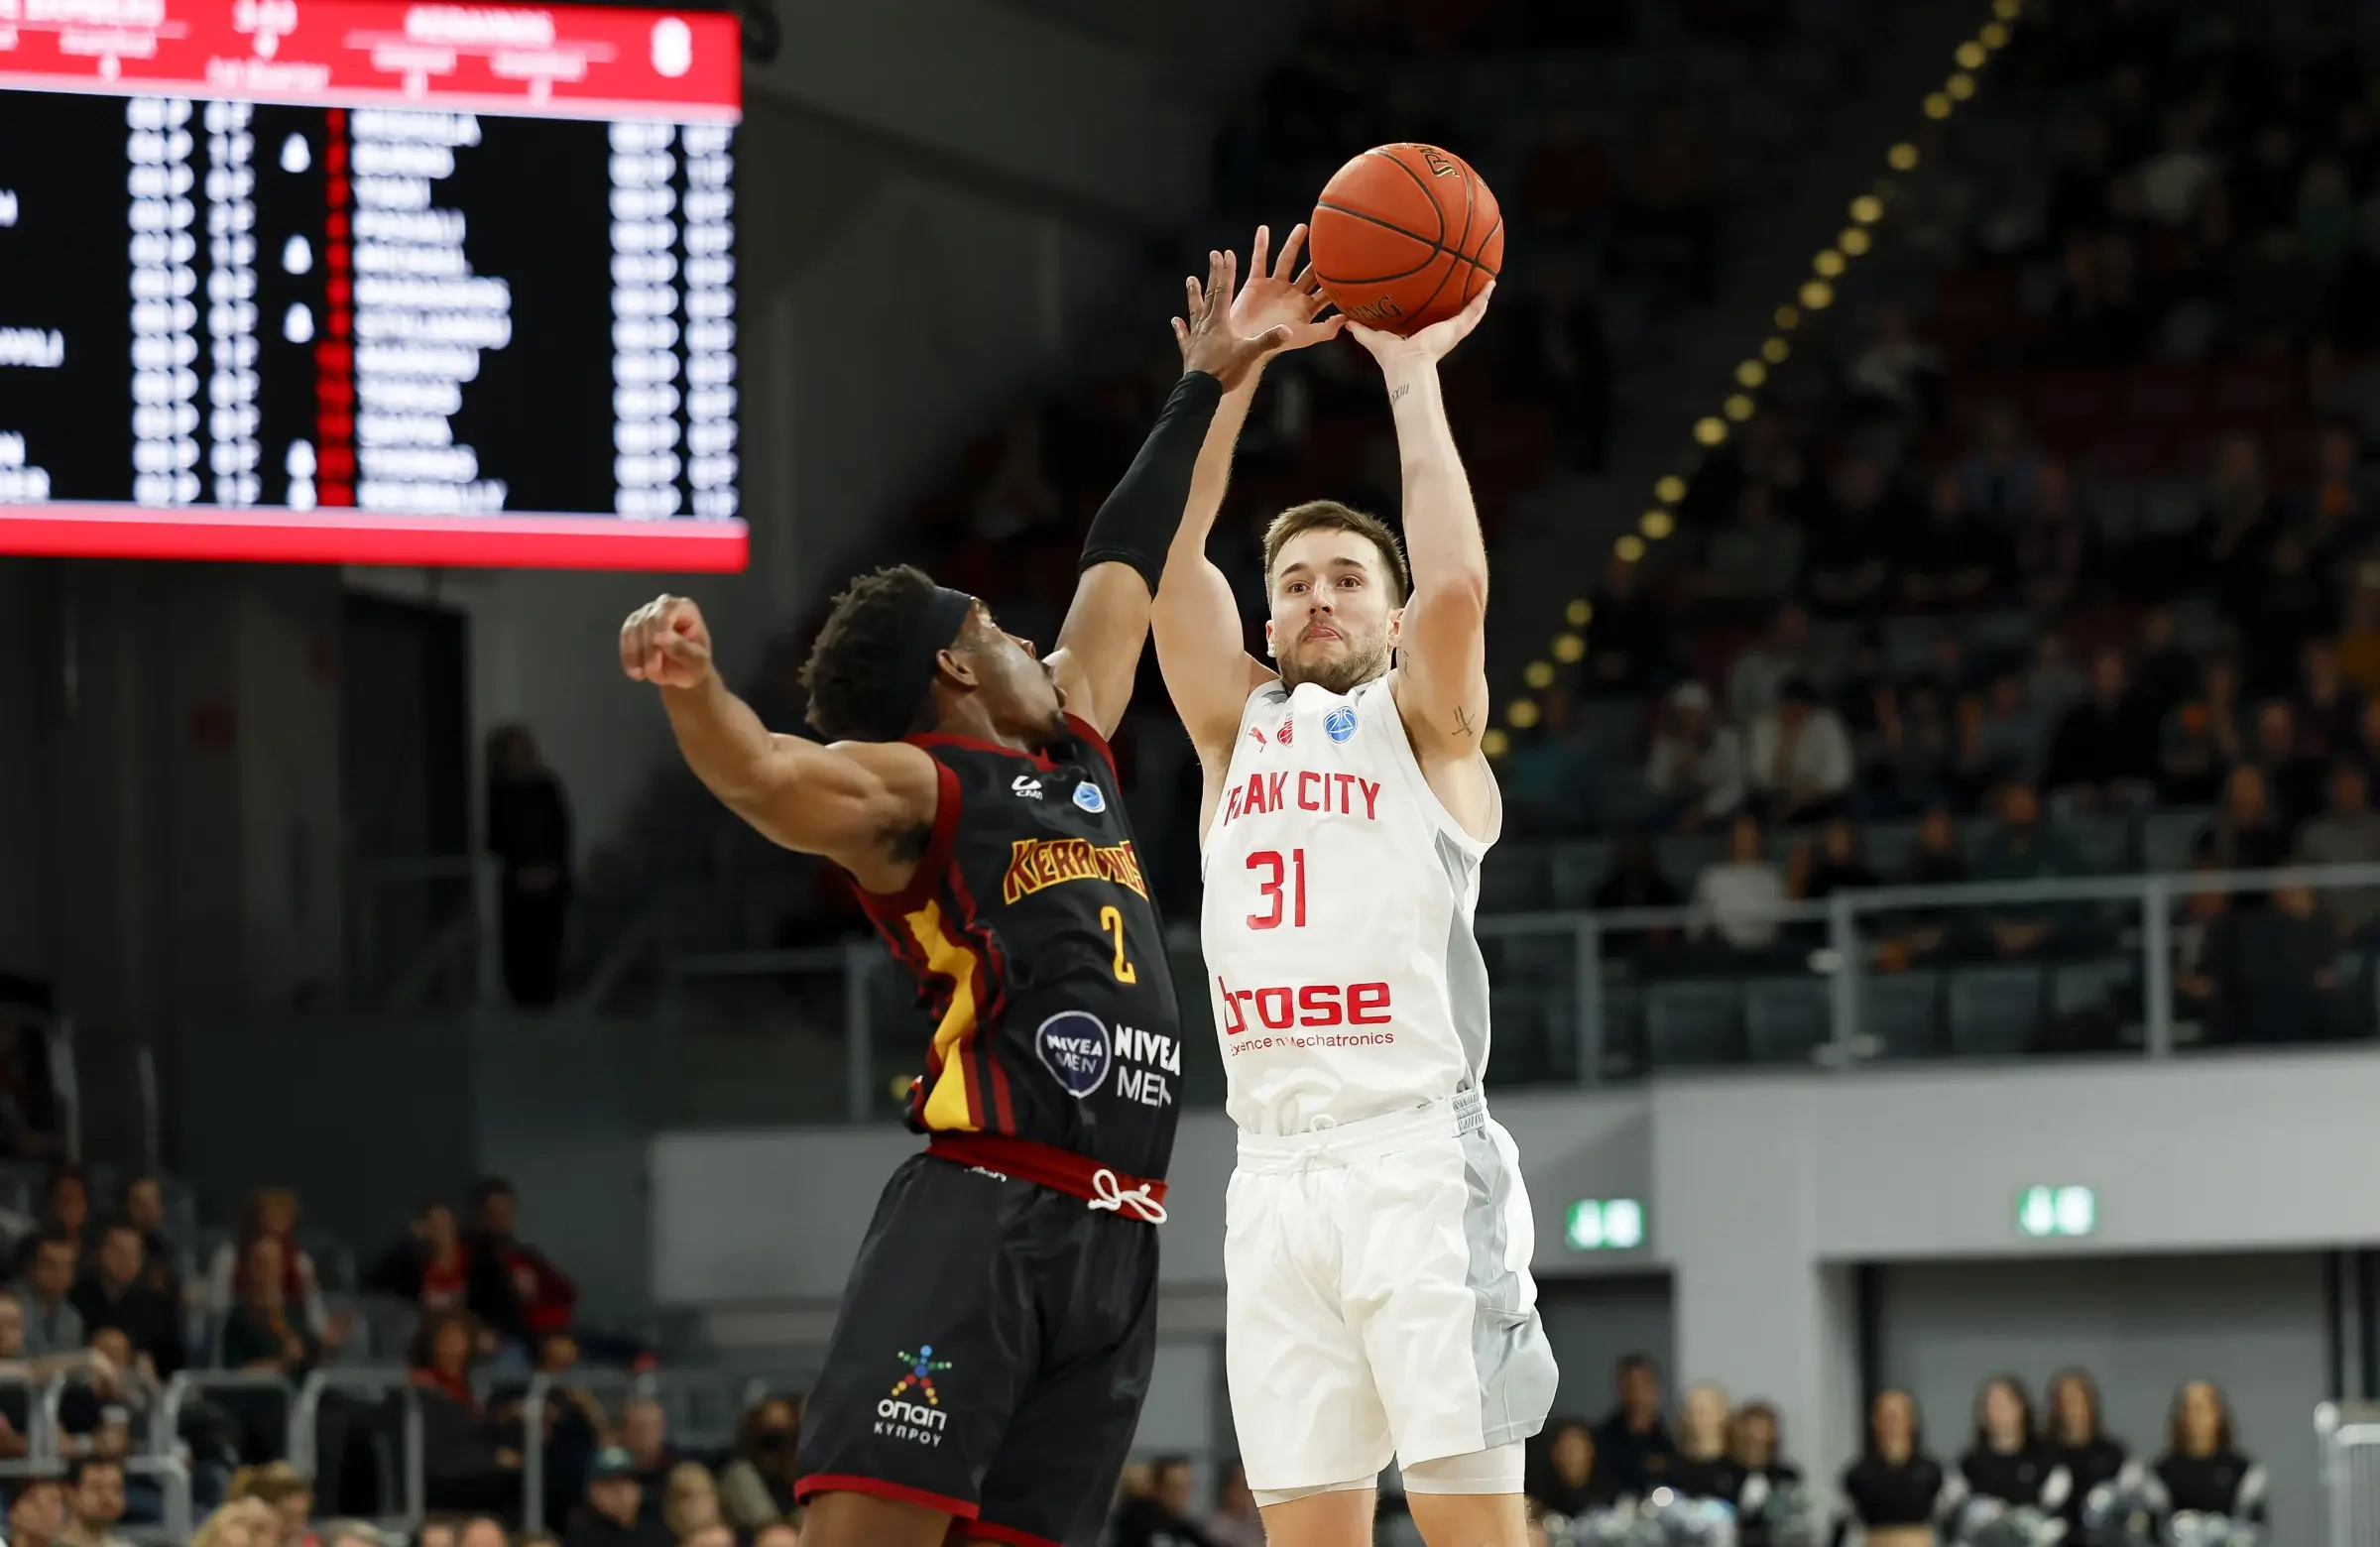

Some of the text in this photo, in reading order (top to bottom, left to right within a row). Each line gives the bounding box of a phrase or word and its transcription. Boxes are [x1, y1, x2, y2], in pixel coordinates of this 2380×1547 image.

[1297, 771, 1381, 821] CITY
[1246, 848, 1306, 931] 31
[1100, 904, 1137, 985] 2
[1218, 975, 1392, 1035] brose
[1046, 1033, 1103, 1058] NIVEA
[1116, 1022, 1182, 1077] NIVEA
